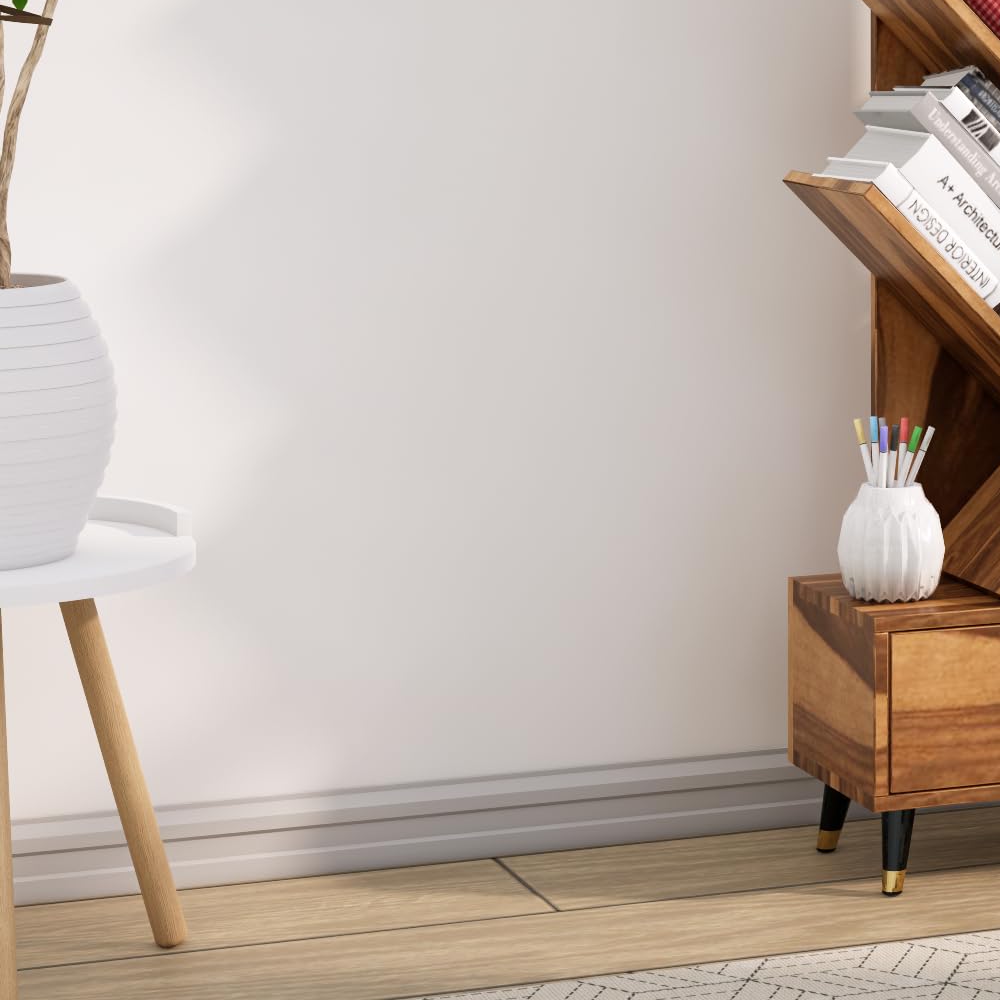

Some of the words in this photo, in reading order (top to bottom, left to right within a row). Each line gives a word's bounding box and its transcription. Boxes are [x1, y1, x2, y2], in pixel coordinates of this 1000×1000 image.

[928, 108, 988, 180] Understanding
[936, 175, 955, 193] A+
[907, 199, 950, 245] DESIGN
[944, 236, 991, 289] INTERIOR
